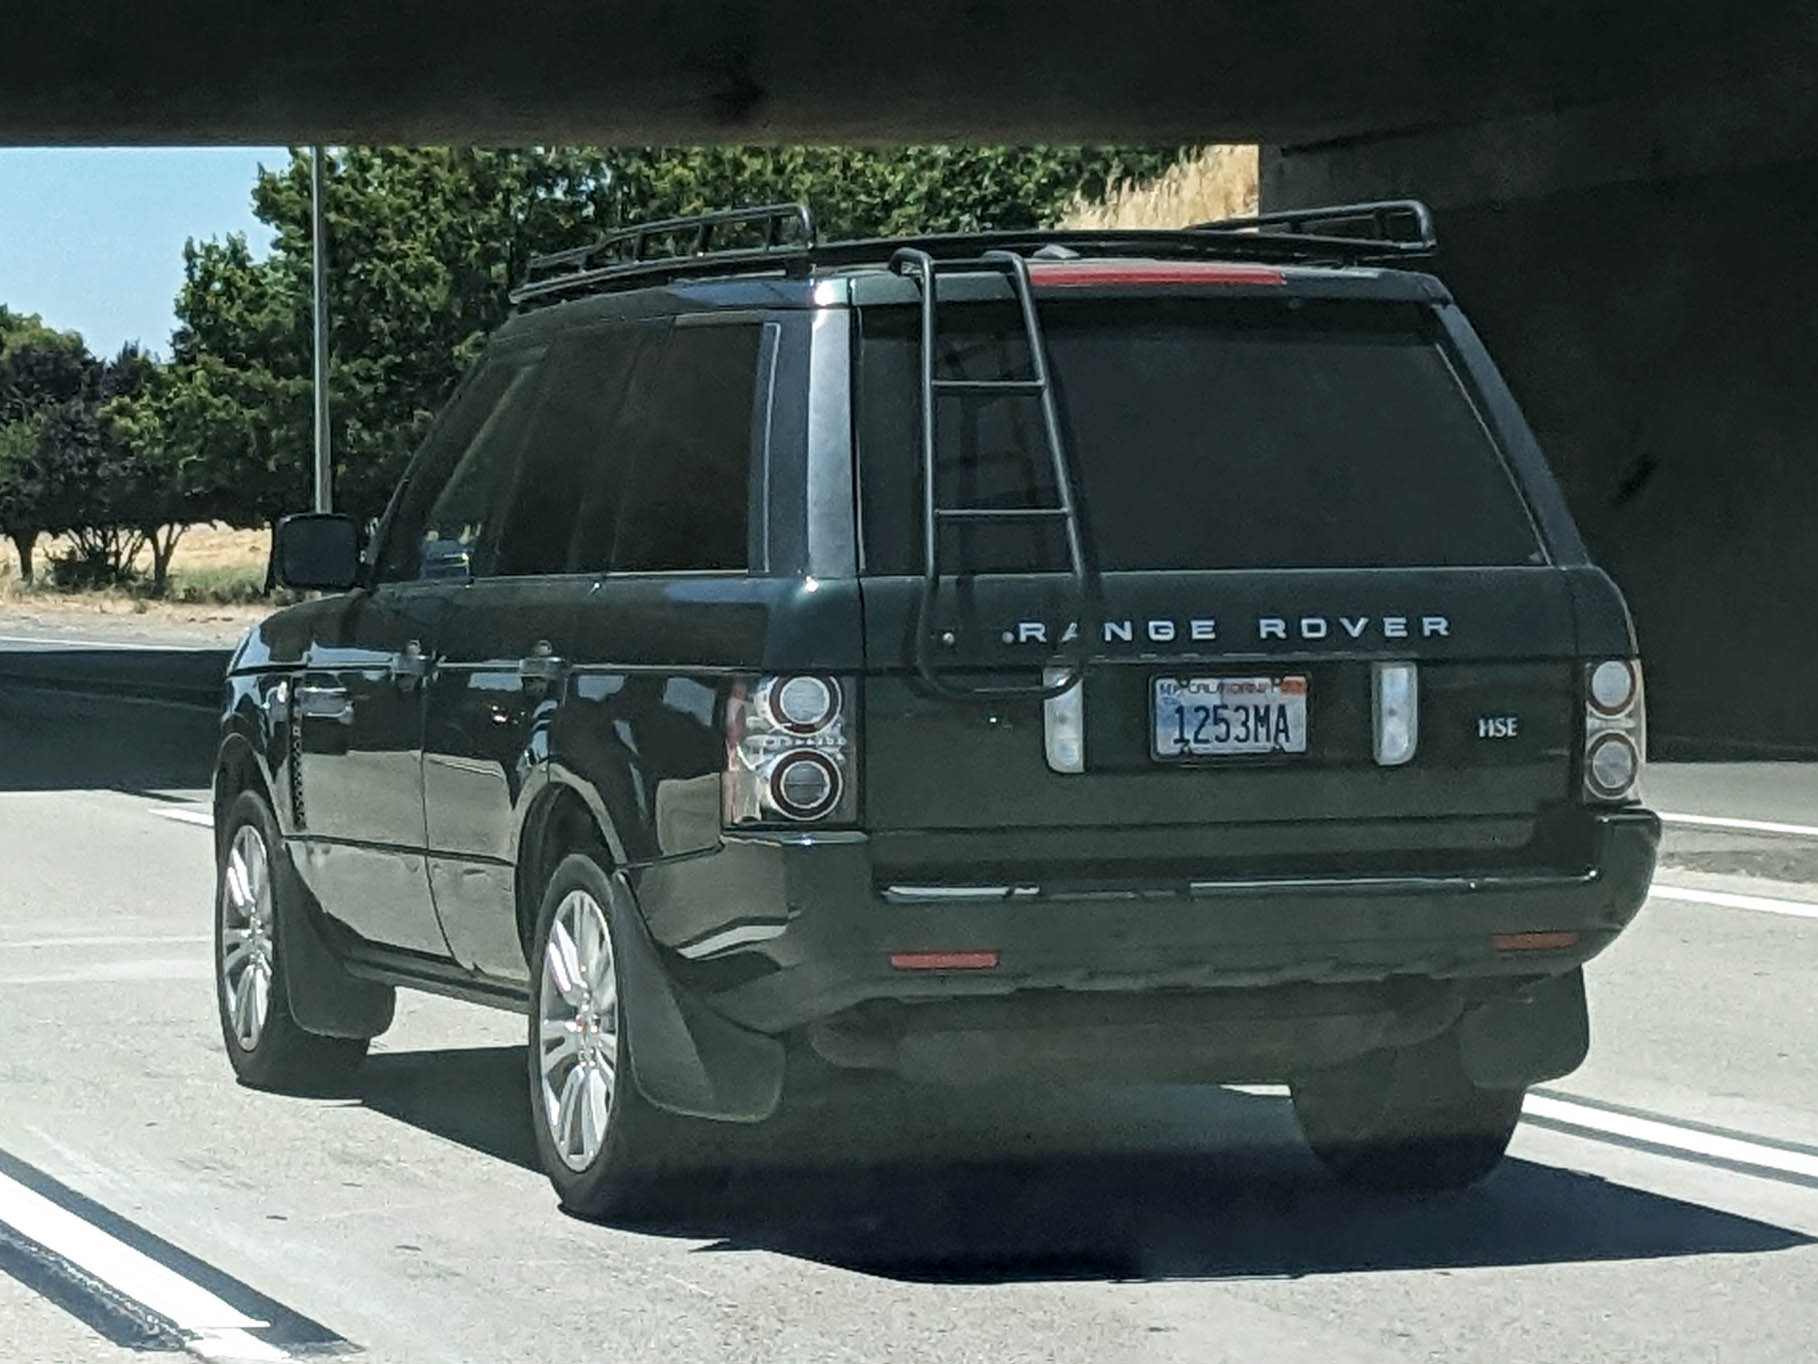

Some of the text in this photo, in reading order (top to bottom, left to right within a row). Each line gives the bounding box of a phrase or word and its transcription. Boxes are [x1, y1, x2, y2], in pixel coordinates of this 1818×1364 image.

[1259, 616, 1451, 639] ROVER
[1173, 703, 1290, 745] 1253MA
[1478, 717, 1518, 738] HSE
